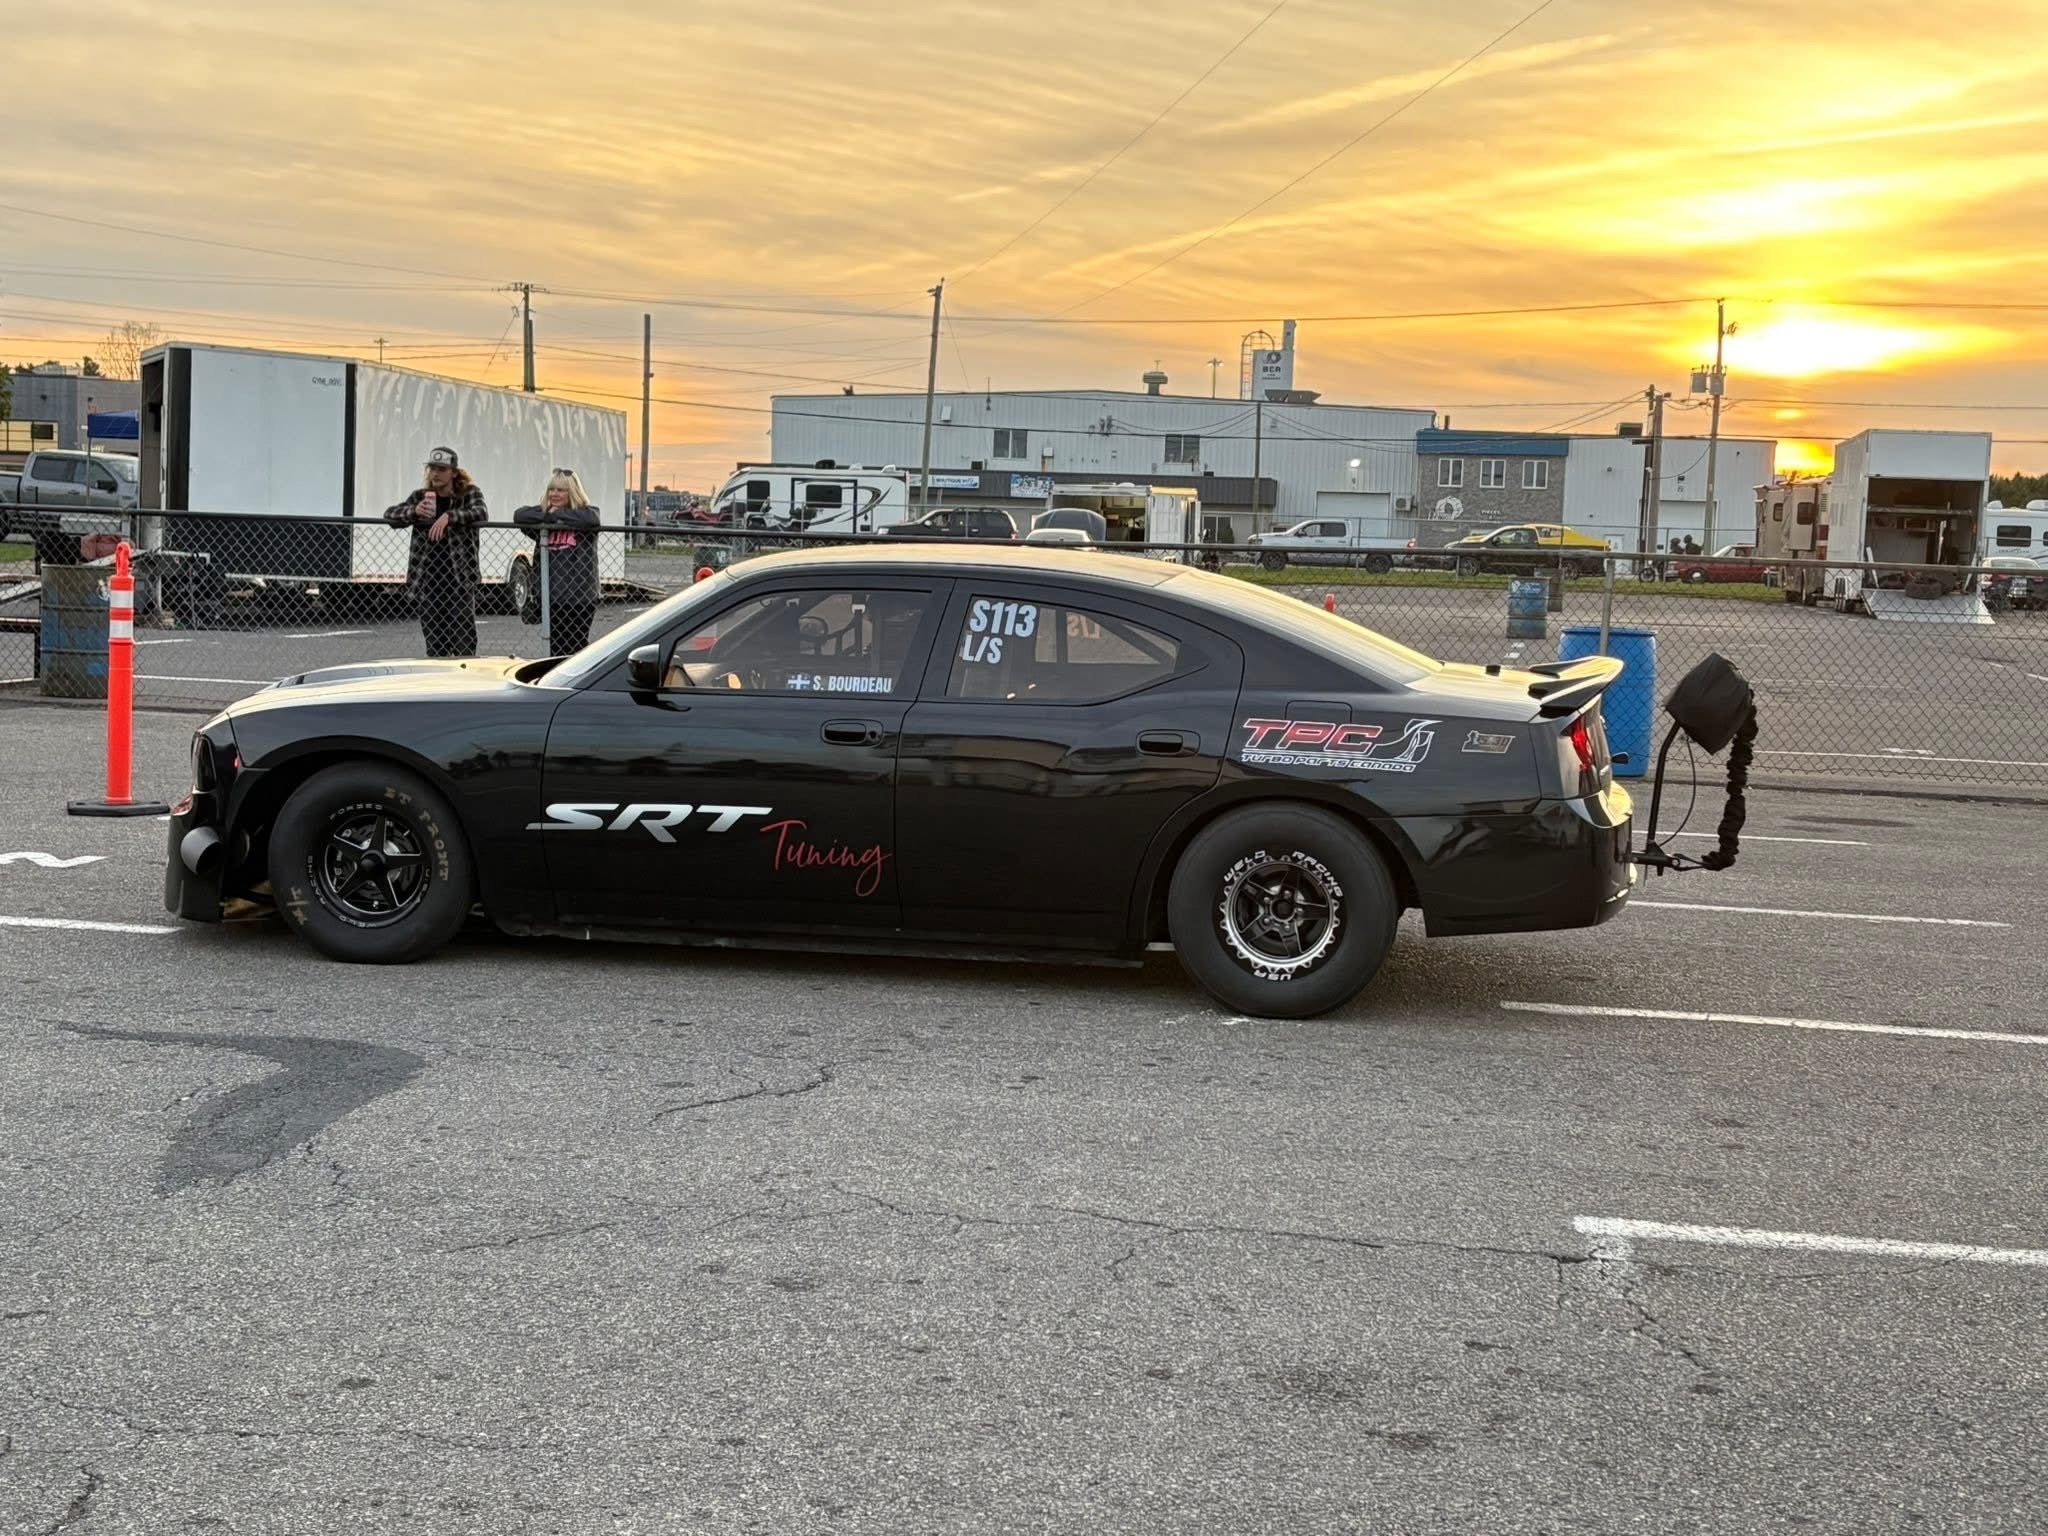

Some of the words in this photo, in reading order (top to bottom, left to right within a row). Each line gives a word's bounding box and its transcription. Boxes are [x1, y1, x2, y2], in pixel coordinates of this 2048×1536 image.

[969, 600, 1037, 637] S113
[962, 635, 1003, 664] L/S
[812, 675, 824, 691] S.
[828, 676, 892, 693] BOURDEAU
[1243, 719, 1383, 756] TPC
[525, 803, 773, 843] SRT
[760, 820, 892, 896] Tuning
[1224, 850, 1266, 882] WELD
[1292, 851, 1344, 897] RACING
[1254, 969, 1292, 981] USA
